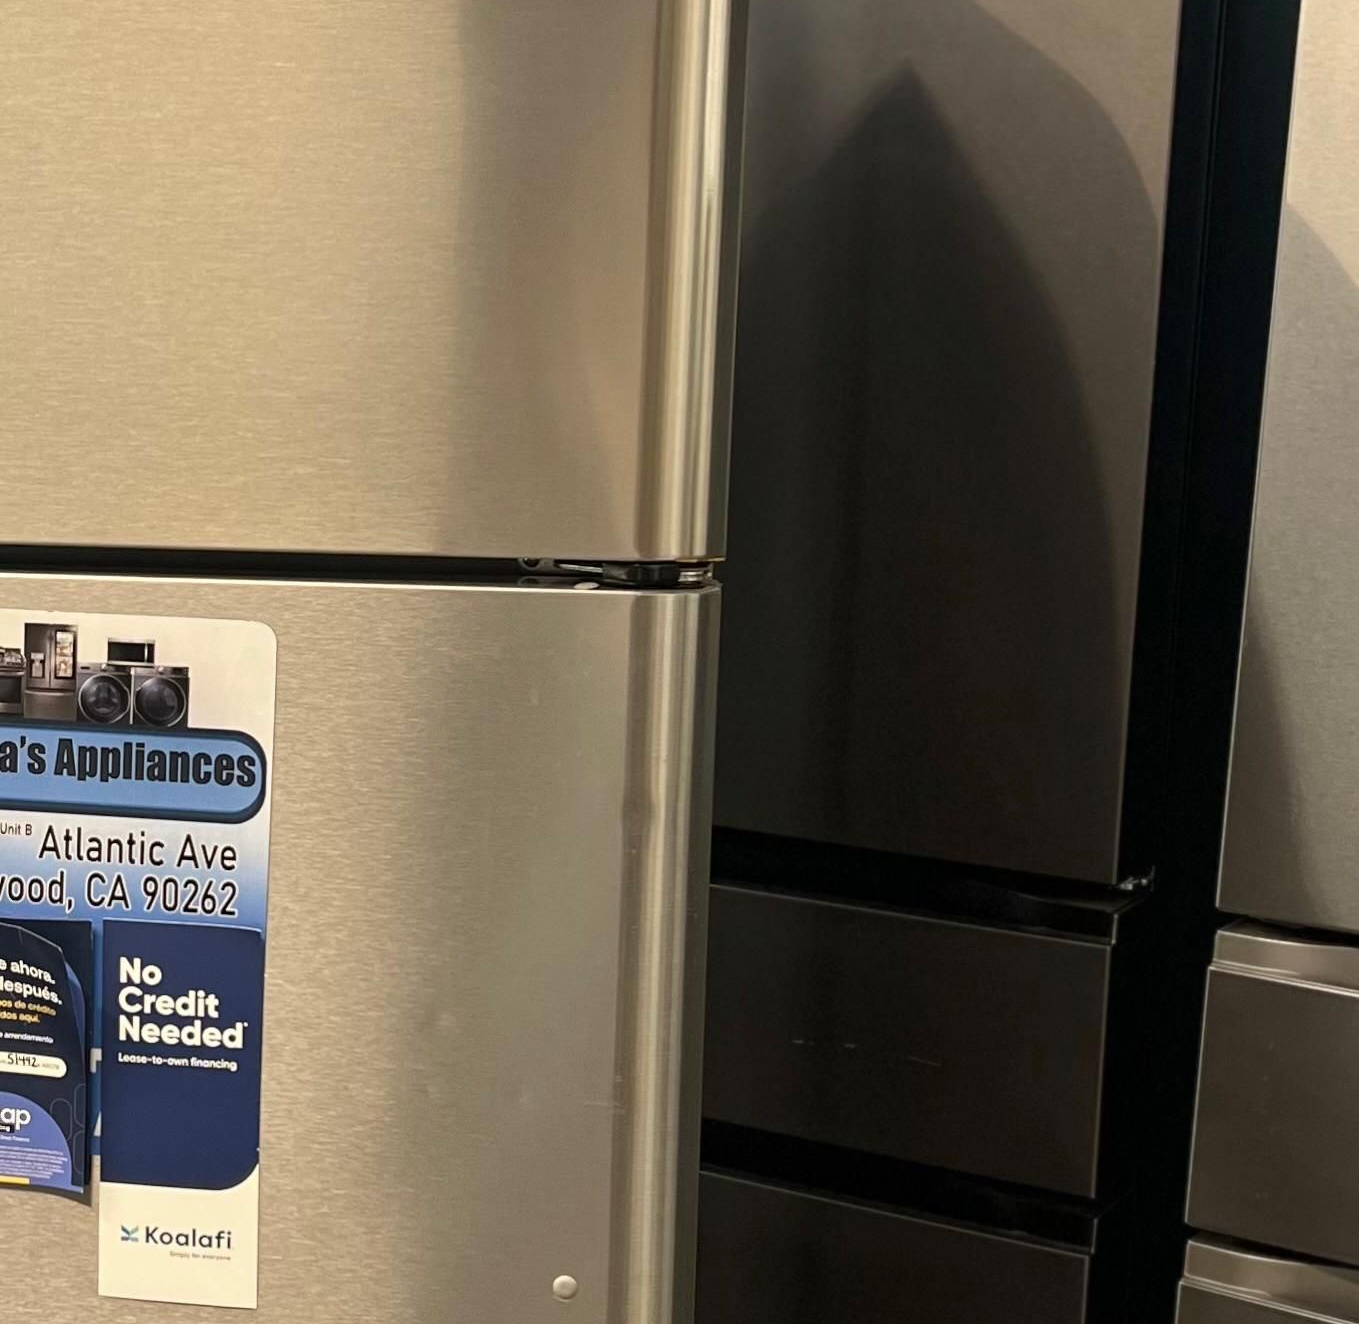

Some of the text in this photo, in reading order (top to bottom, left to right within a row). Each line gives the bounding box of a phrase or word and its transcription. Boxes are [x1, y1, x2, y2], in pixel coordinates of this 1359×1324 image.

[54, 738, 256, 787] Appliances
[0, 823, 21, 835] Unit
[25, 824, 33, 836] B
[38, 825, 165, 866] Atlantic
[176, 834, 238, 871] Ave
[87, 874, 130, 909] CA
[143, 877, 238, 916] 90262
[10, 960, 56, 985] ahora.
[119, 956, 163, 986] No
[14, 999, 26, 1010] de
[118, 986, 220, 1018] Credit
[118, 1052, 238, 1072] Lease-to-own financing
[145, 1226, 232, 1250] Koalafi
